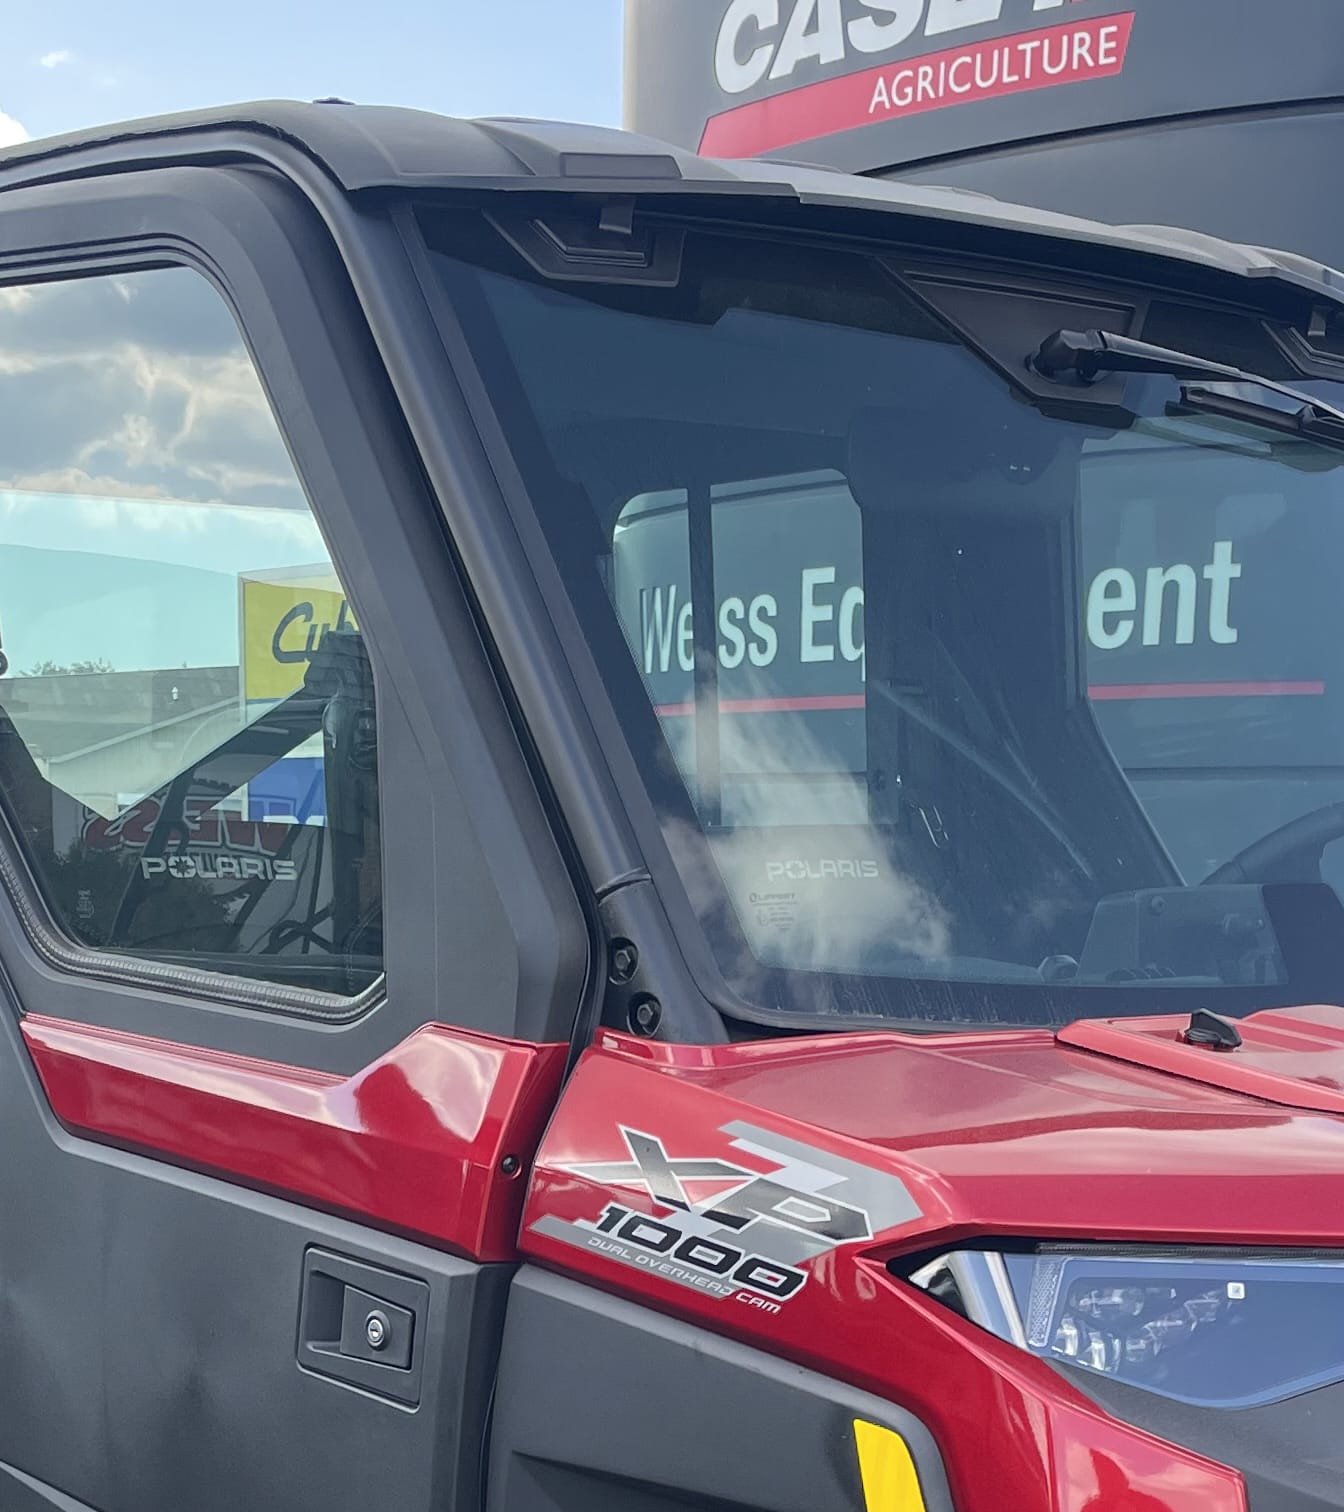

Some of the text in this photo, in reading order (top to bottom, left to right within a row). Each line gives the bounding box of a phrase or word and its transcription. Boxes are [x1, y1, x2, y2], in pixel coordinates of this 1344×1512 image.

[868, 25, 1119, 114] AGRICULTURE
[640, 584, 778, 674] Wess
[140, 855, 298, 881] POLARIS
[765, 859, 880, 882] POLARIS
[552, 1122, 874, 1245] XP
[587, 1236, 782, 1314] DUAL OVERHEAD CAM
[595, 1201, 809, 1301] 1000
